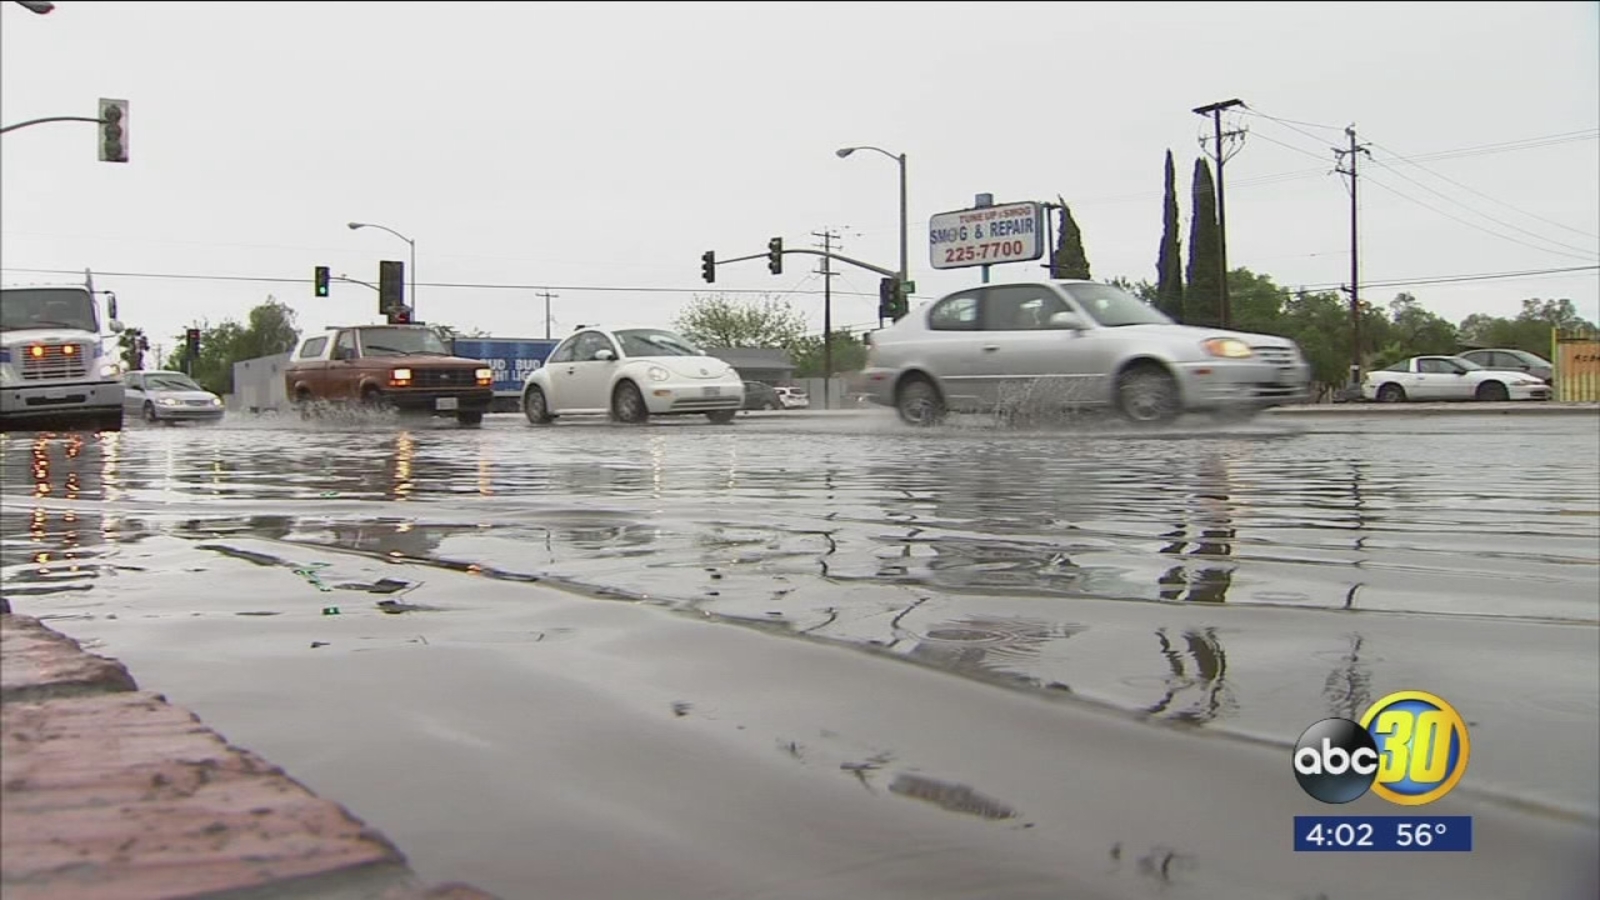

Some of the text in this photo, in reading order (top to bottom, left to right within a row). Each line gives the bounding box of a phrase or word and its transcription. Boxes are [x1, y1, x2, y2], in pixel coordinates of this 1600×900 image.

[930, 218, 1034, 245] SMOG & REPAIR
[945, 240, 1023, 263] 225-7700
[515, 359, 541, 370] BUD
